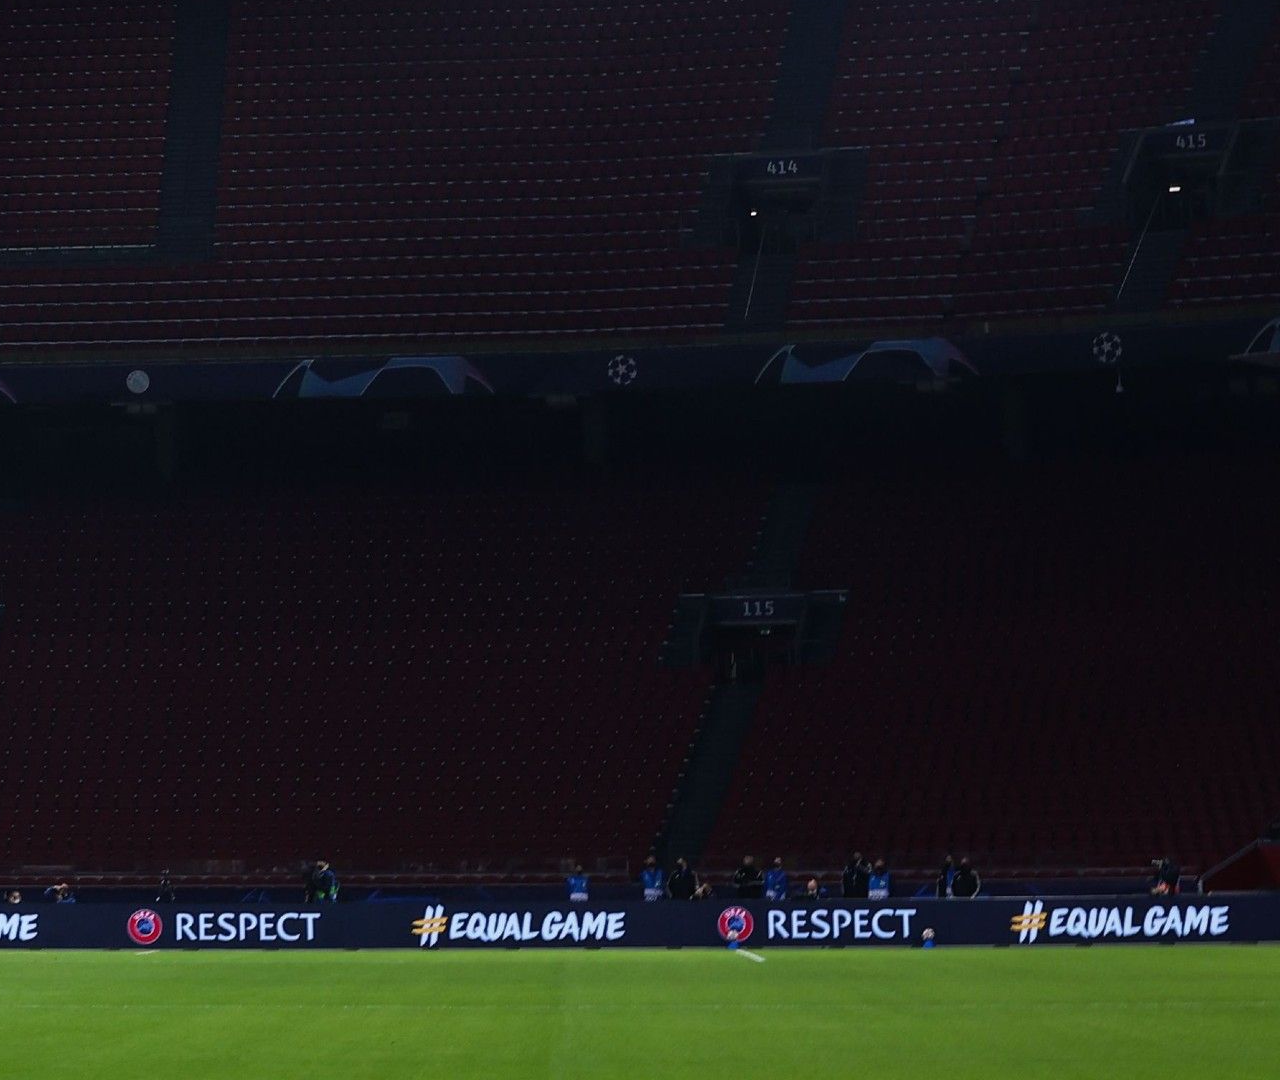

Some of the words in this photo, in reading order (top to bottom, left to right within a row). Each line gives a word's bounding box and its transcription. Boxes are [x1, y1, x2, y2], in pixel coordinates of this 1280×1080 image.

[1175, 133, 1206, 149] 415
[767, 160, 798, 174] 414
[743, 600, 774, 616] 115
[176, 912, 322, 941] RESPECT
[767, 908, 917, 940] RESPECT
